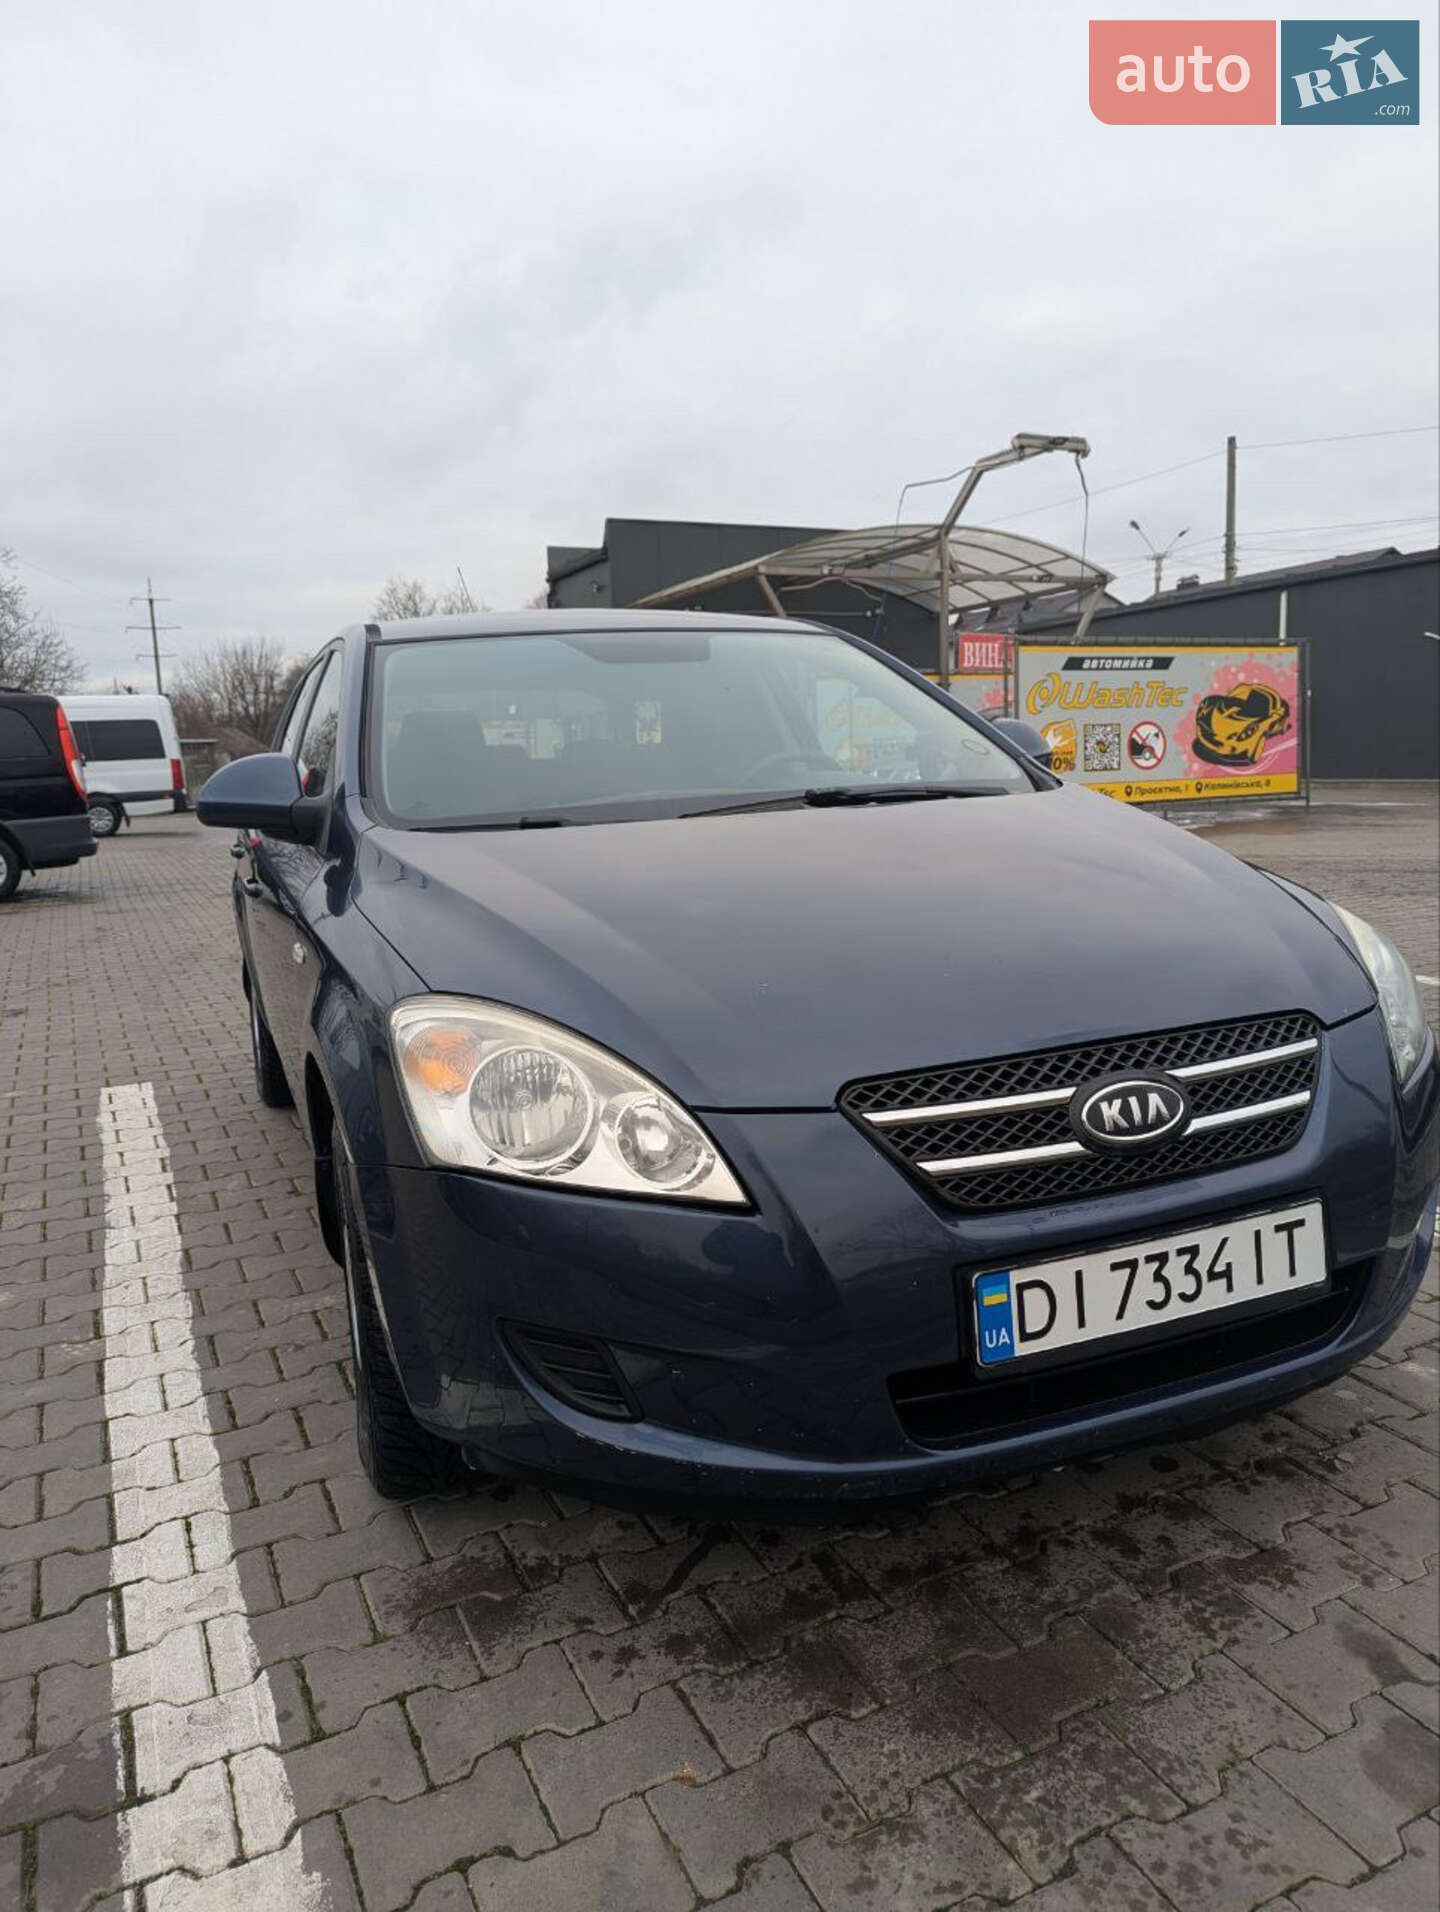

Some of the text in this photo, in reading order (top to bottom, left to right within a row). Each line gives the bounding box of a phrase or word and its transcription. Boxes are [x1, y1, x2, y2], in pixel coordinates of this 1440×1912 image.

[1058, 679, 1188, 710] WashTec
[1053, 756, 1076, 771] 0%
[1099, 1092, 1170, 1132] KIA
[1016, 1218, 1306, 1343] DI 7334 IT
[985, 1327, 1010, 1348] UA
